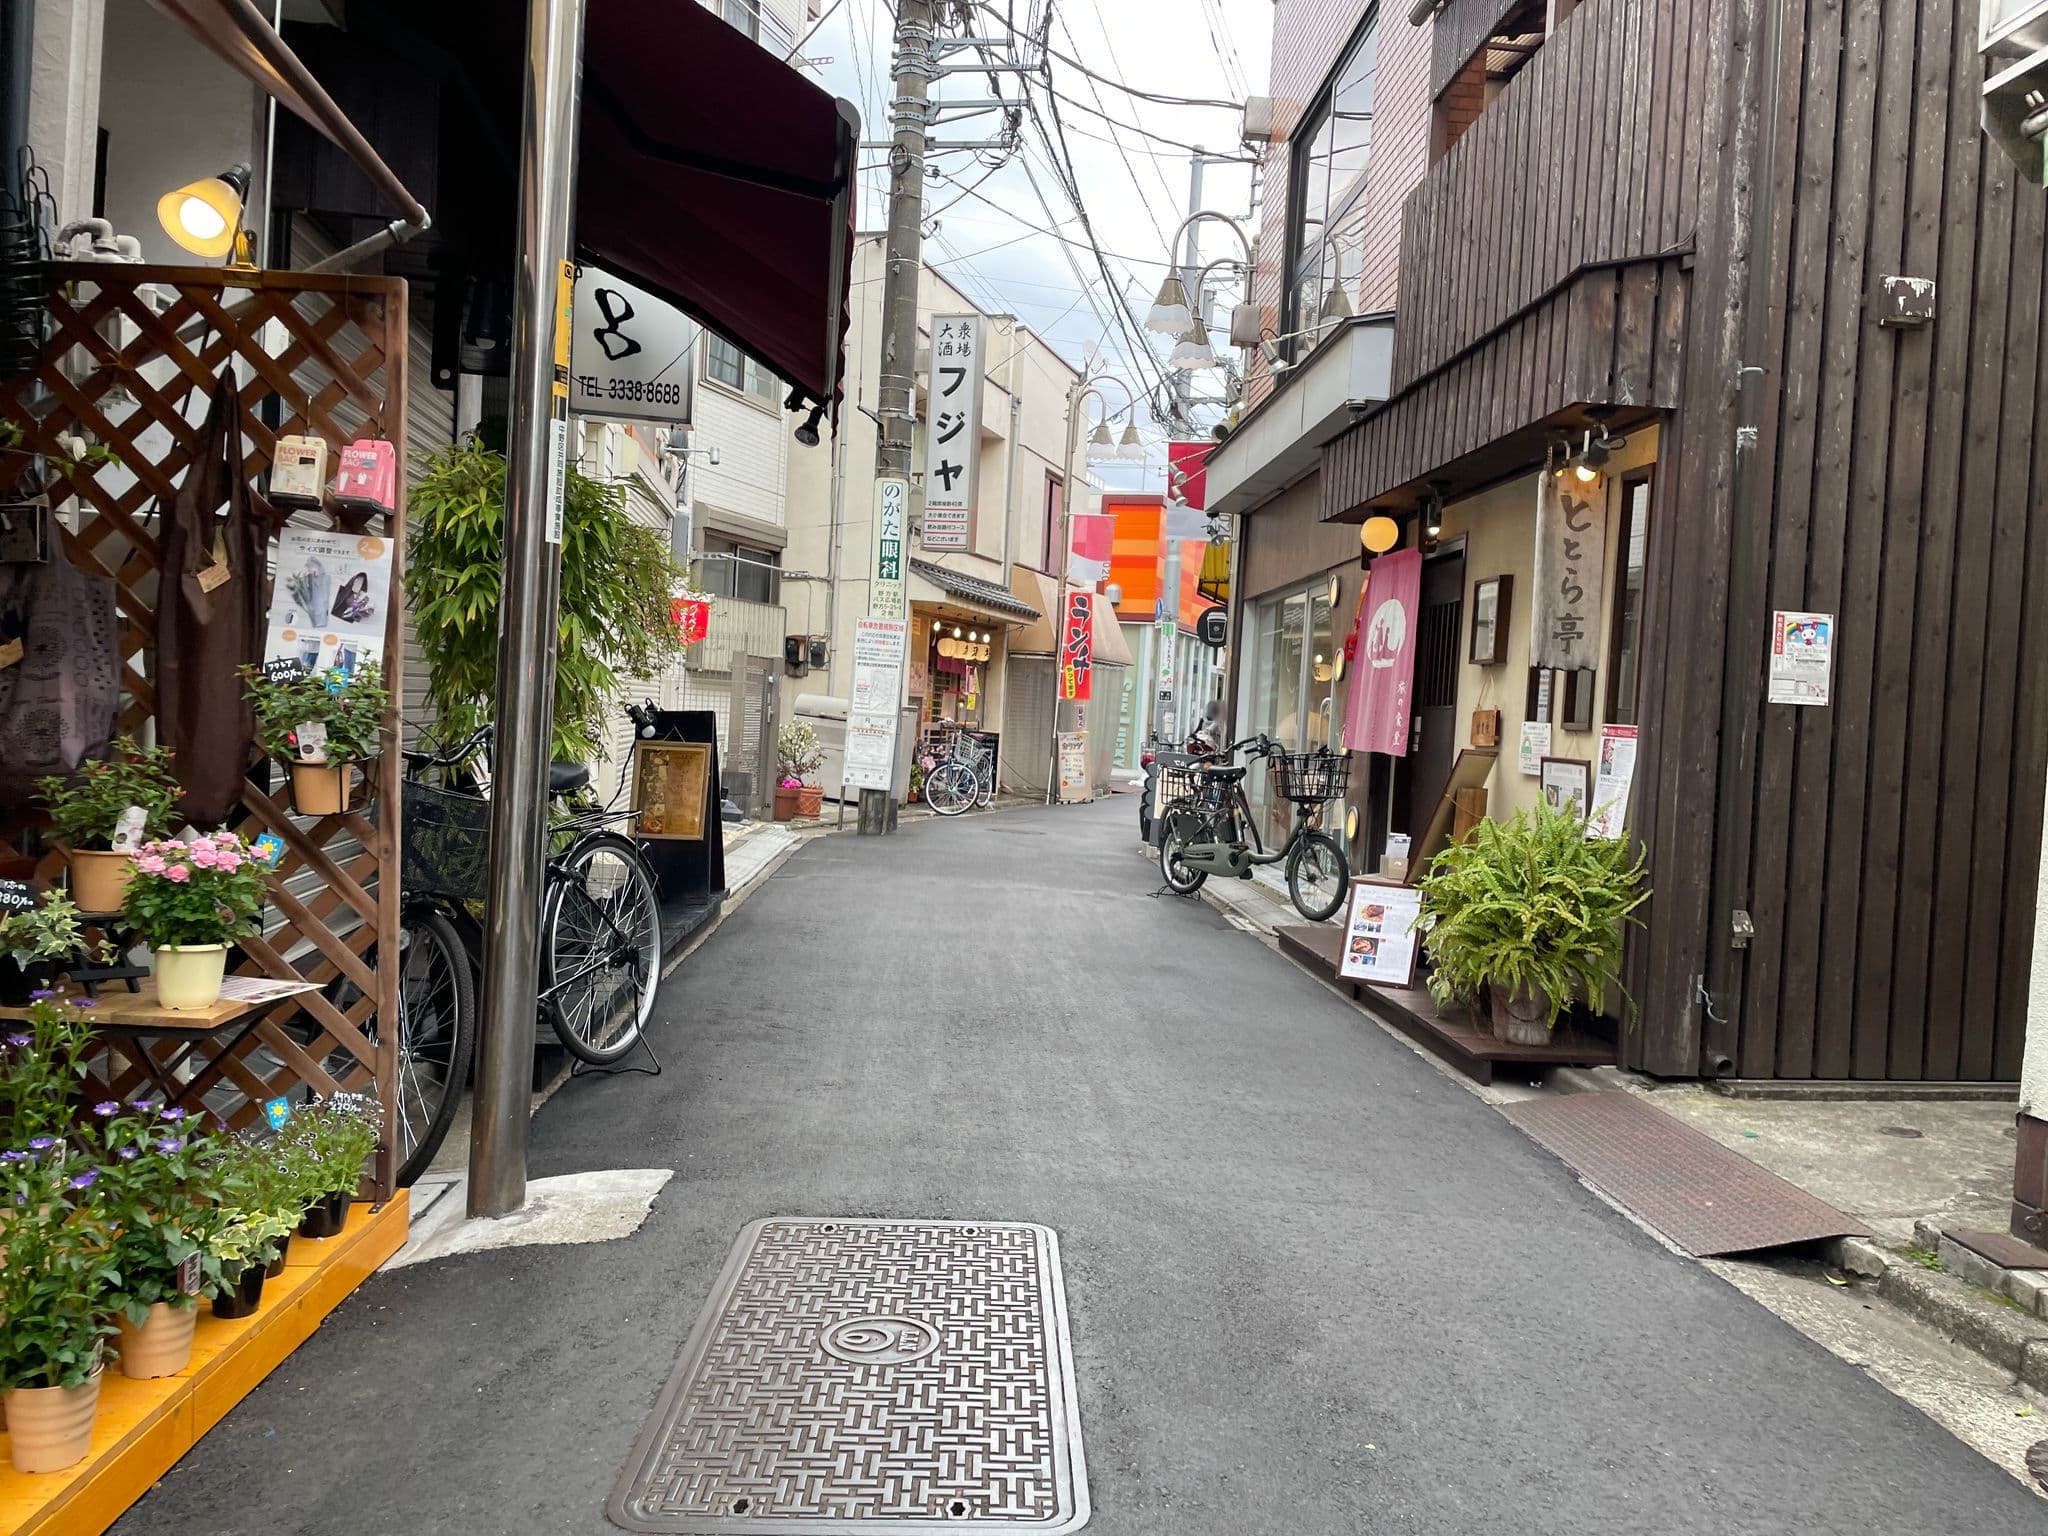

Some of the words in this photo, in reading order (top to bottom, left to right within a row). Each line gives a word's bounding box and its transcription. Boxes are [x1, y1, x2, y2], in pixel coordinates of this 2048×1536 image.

[579, 376, 602, 397] TEL
[278, 446, 317, 457] FLOWER
[343, 449, 378, 460] FLOWER
[934, 367, 967, 492] フジヤ
[342, 458, 361, 467] BAG
[880, 484, 901, 579] のがた眼科
[1552, 494, 1593, 655] ととら亭
[1069, 596, 1090, 684] ランチ
